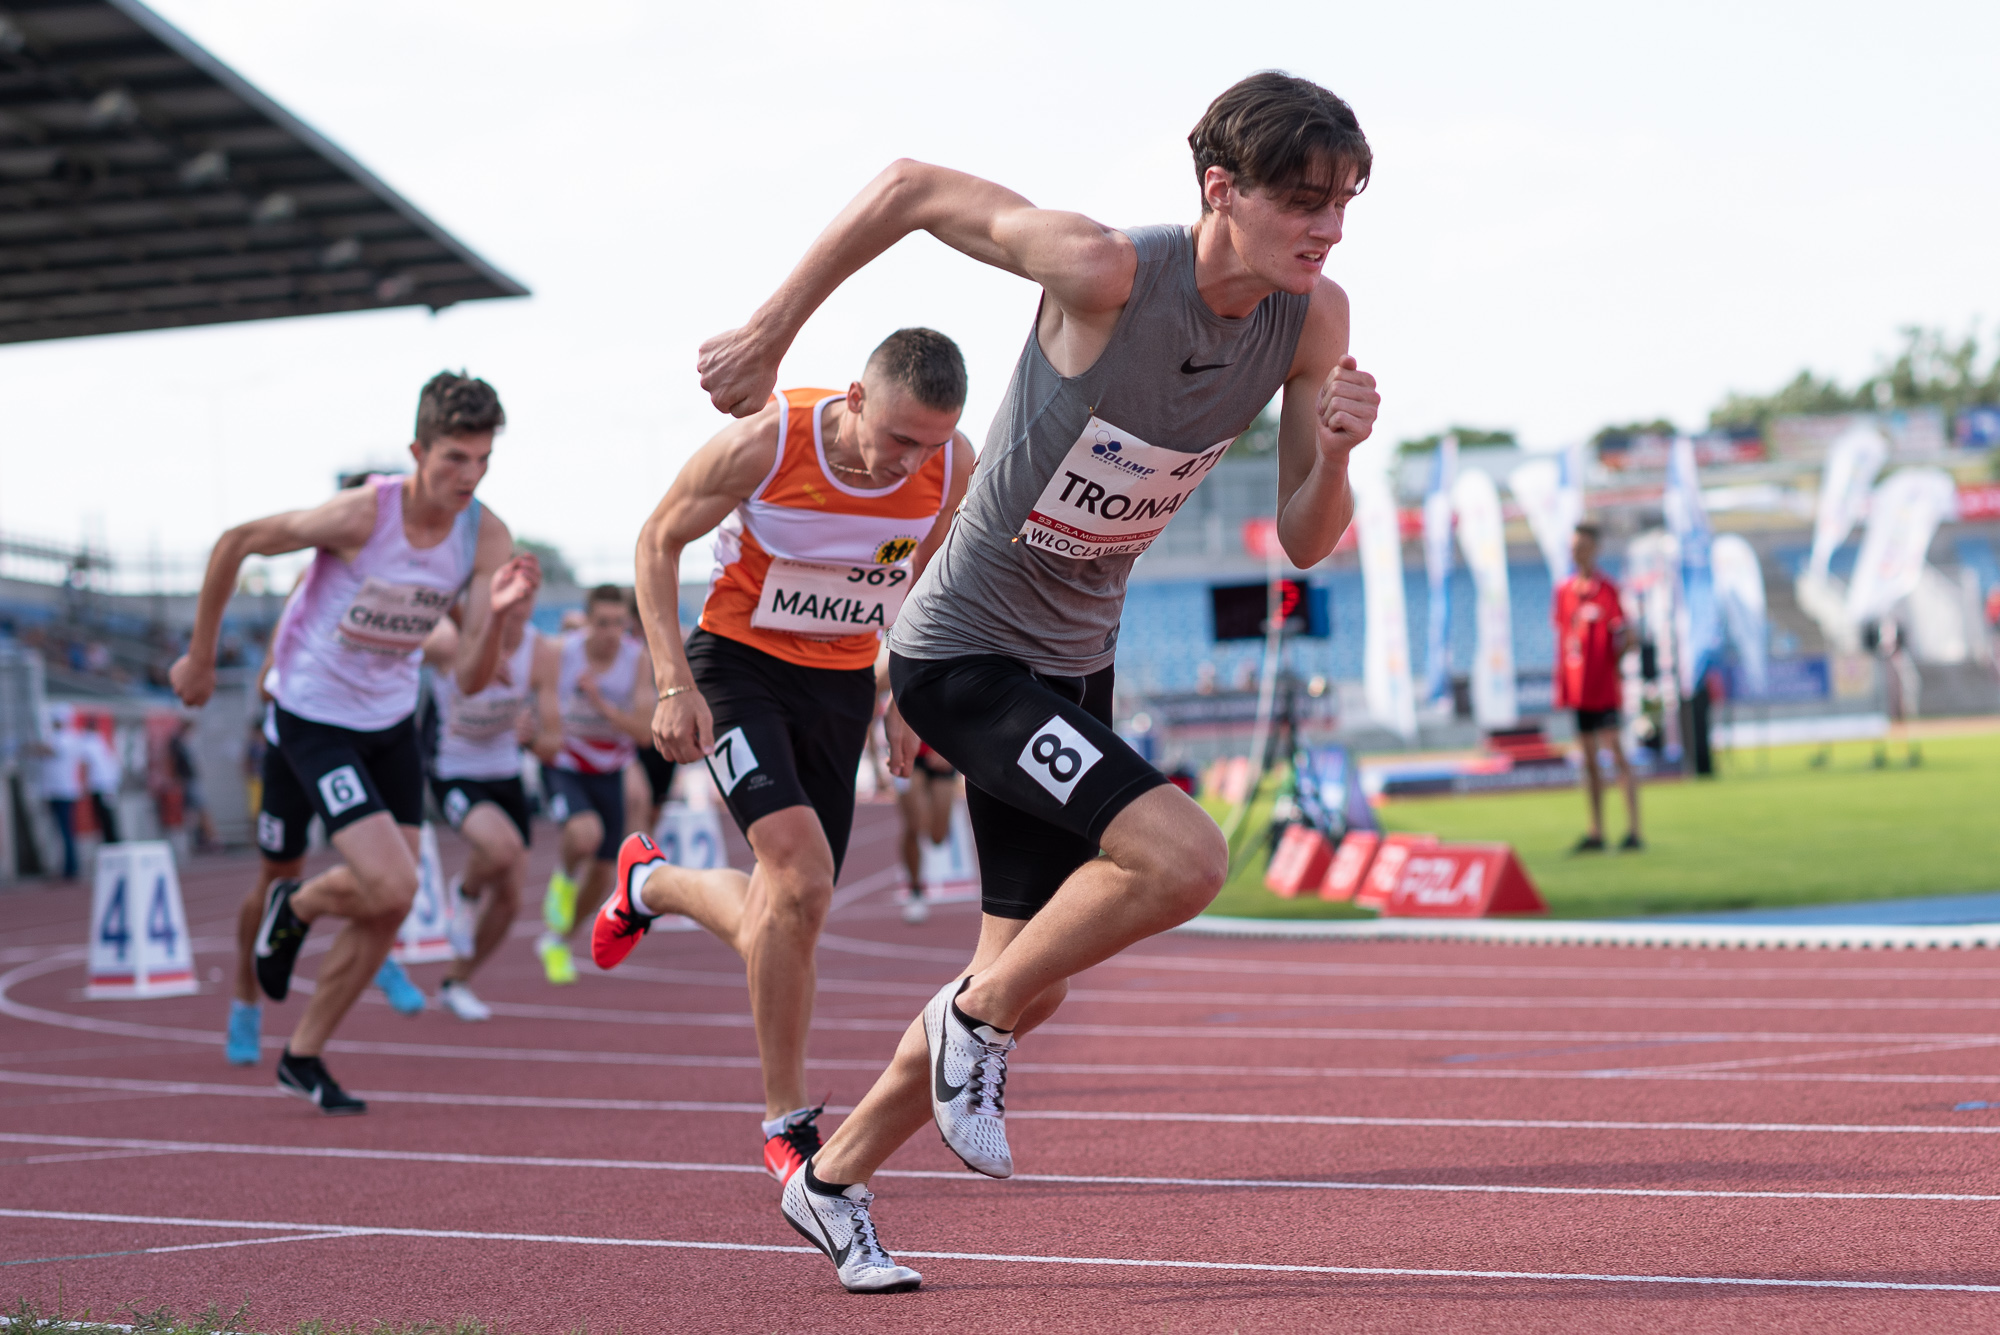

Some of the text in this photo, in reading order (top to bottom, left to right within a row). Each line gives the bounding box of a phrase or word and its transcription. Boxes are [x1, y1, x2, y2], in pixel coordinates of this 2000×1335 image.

[1091, 454, 1148, 480] SPORT NUTRITION
[1103, 452, 1156, 475] OLIMP
[1170, 444, 1228, 481] 471
[1031, 527, 1136, 557] WŁOCŁAWEK
[1037, 516, 1053, 527] 53.
[1054, 522, 1079, 536] PZLA
[1079, 532, 1138, 542] MISTRZOSTWA
[771, 588, 885, 627] MAKIŁA
[714, 736, 737, 781] 7
[1031, 733, 1083, 783] 8
[331, 775, 354, 804] 6
